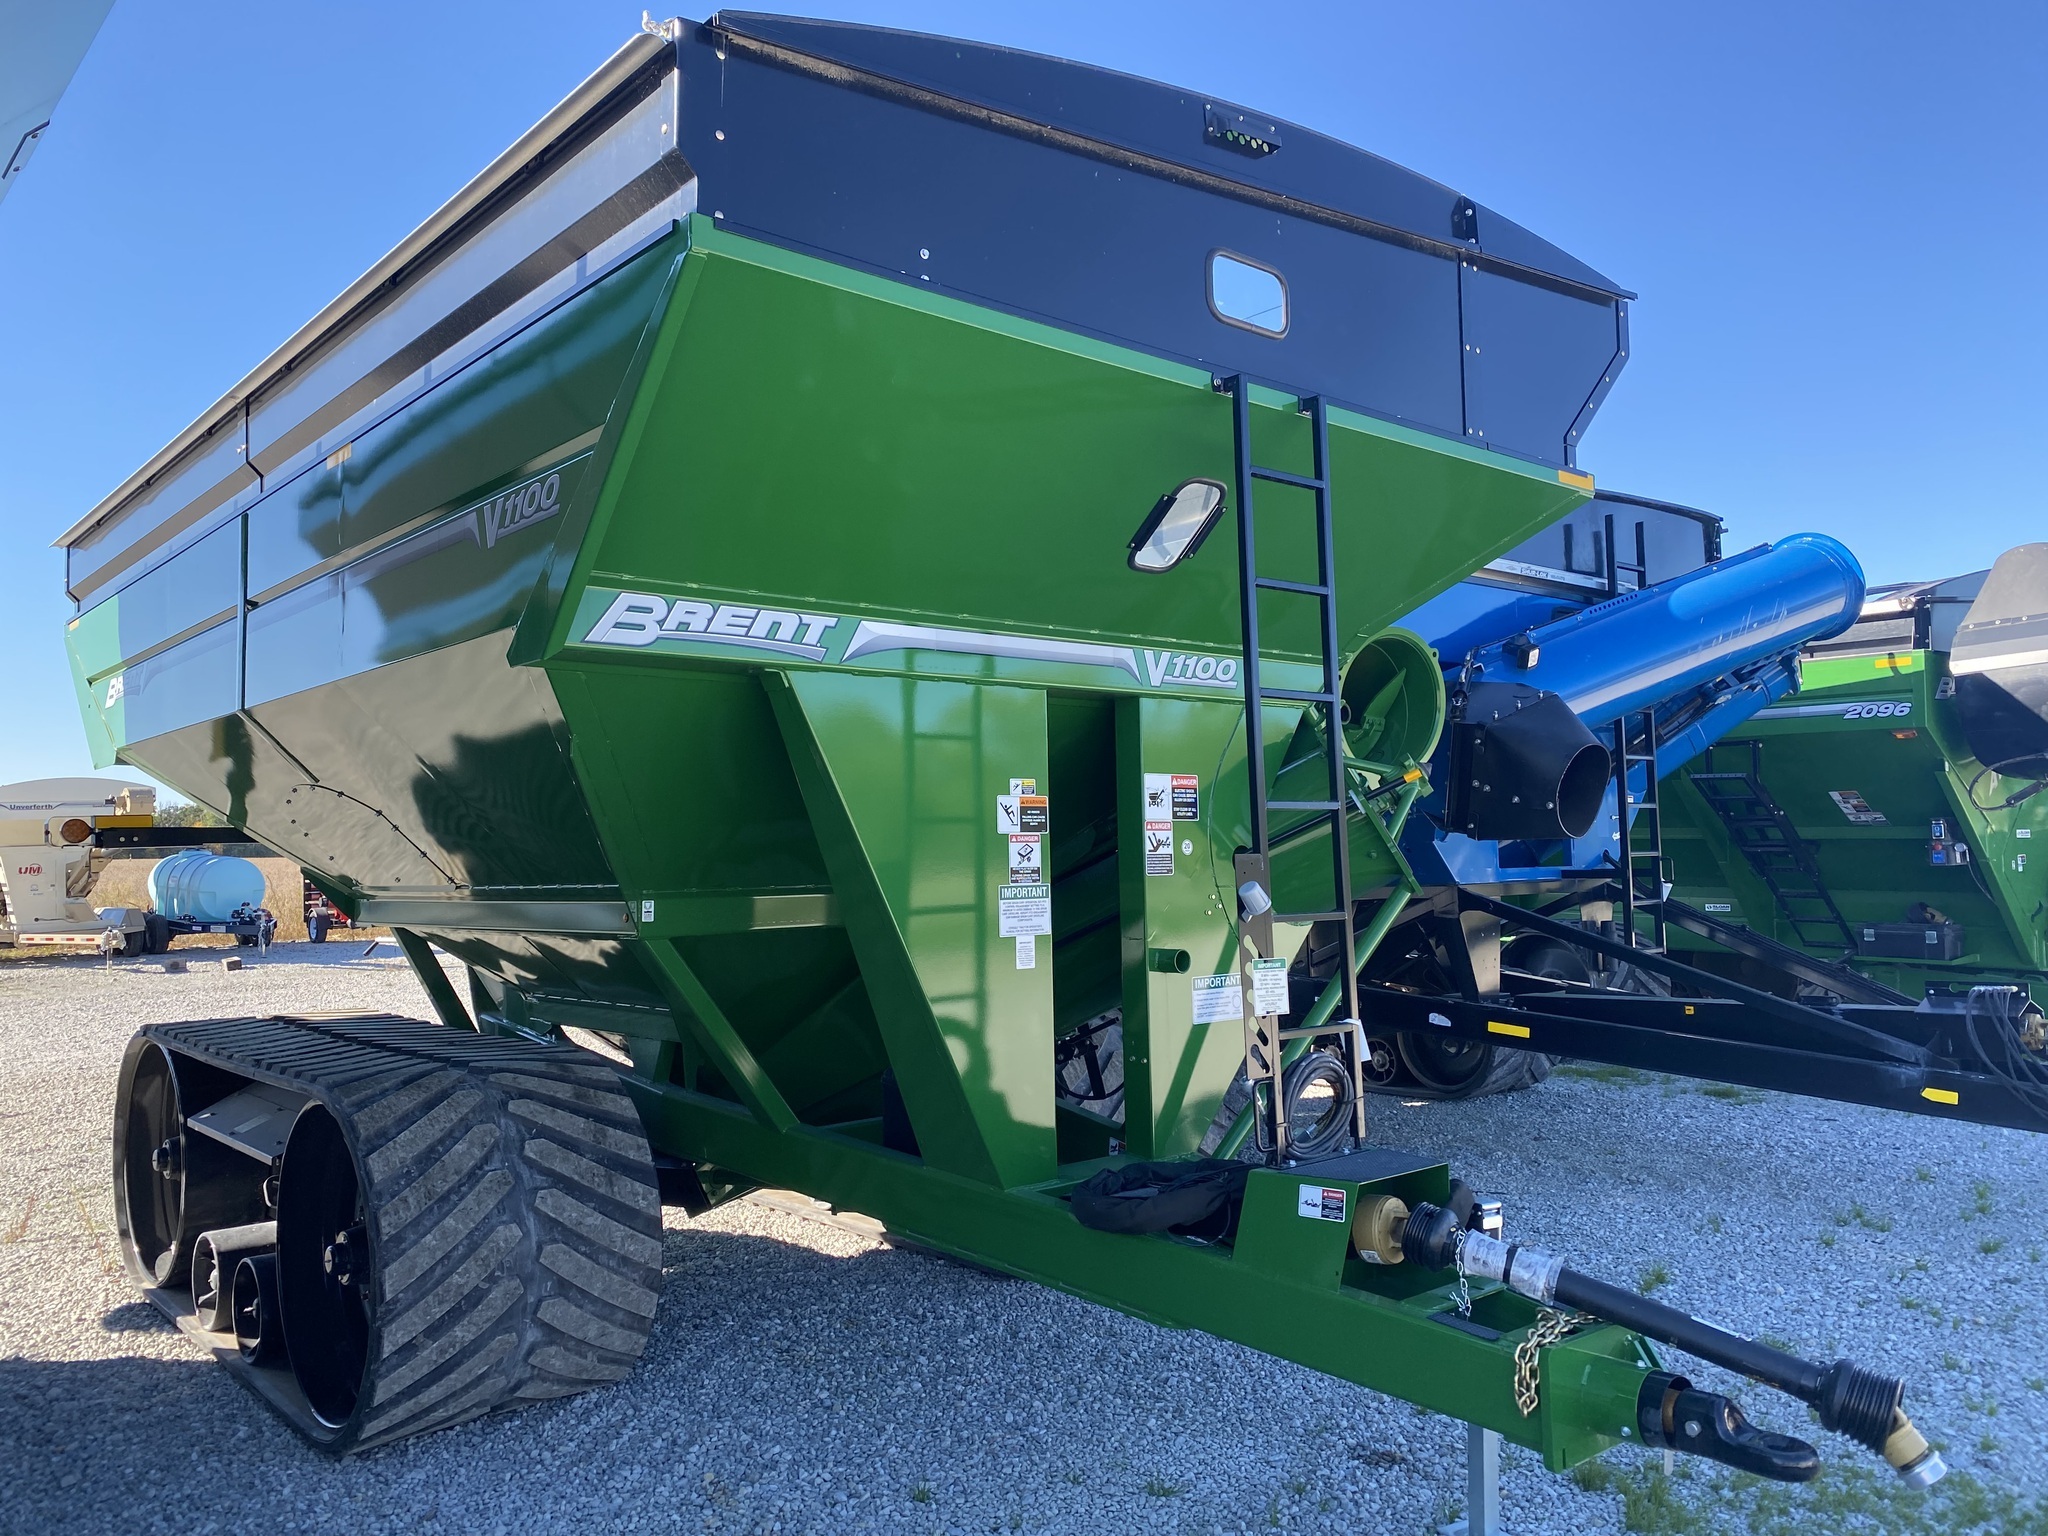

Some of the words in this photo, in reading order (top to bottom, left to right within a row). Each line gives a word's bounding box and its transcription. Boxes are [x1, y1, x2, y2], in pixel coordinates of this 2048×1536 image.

[484, 474, 560, 549] V1100
[584, 591, 839, 647] BRENT
[1143, 649, 1237, 687] V1100
[1843, 702, 1913, 719] 2096
[1001, 887, 1047, 898] IMPORTANT
[1195, 976, 1240, 989] IMPORTANT
